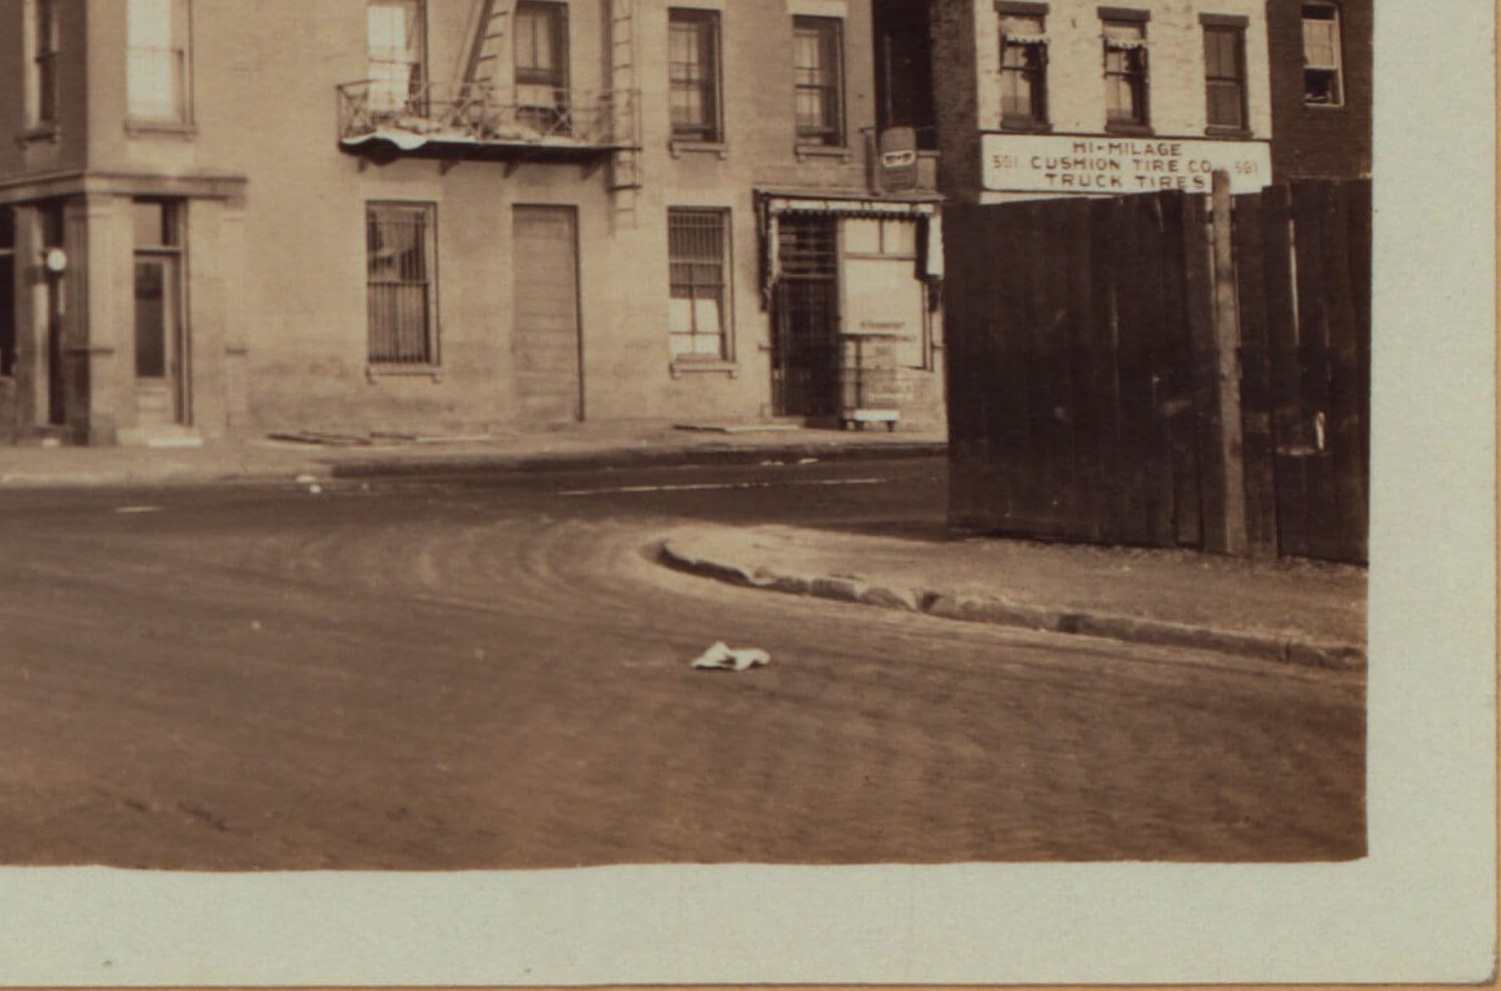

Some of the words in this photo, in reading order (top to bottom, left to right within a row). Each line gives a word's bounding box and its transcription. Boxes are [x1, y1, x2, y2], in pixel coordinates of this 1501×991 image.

[1073, 141, 1182, 156] HI-MILAGE
[1030, 155, 1121, 171] CUSHION
[1133, 158, 1179, 173] TIRE
[1044, 172, 1123, 188] TRUCK
[1135, 174, 1205, 190] TIRES
